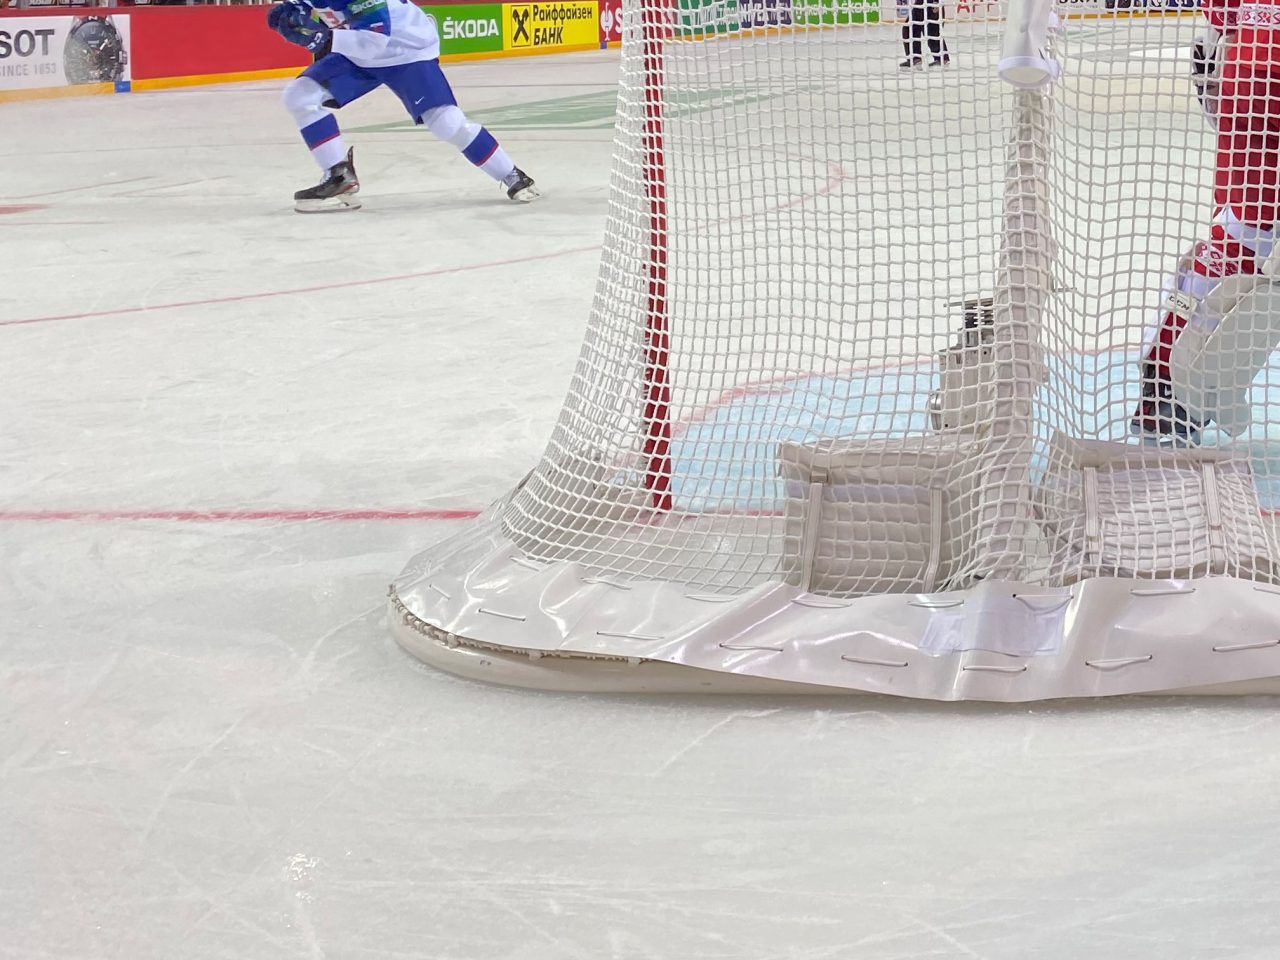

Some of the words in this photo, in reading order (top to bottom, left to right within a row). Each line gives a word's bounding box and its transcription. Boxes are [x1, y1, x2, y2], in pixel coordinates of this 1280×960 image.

[532, 4, 593, 24] Райффайзен
[442, 16, 500, 40] ŠKODA
[533, 26, 564, 46] БАНК
[0, 28, 56, 58] SOT
[0, 64, 30, 78] INCE
[33, 62, 57, 76] 1853
